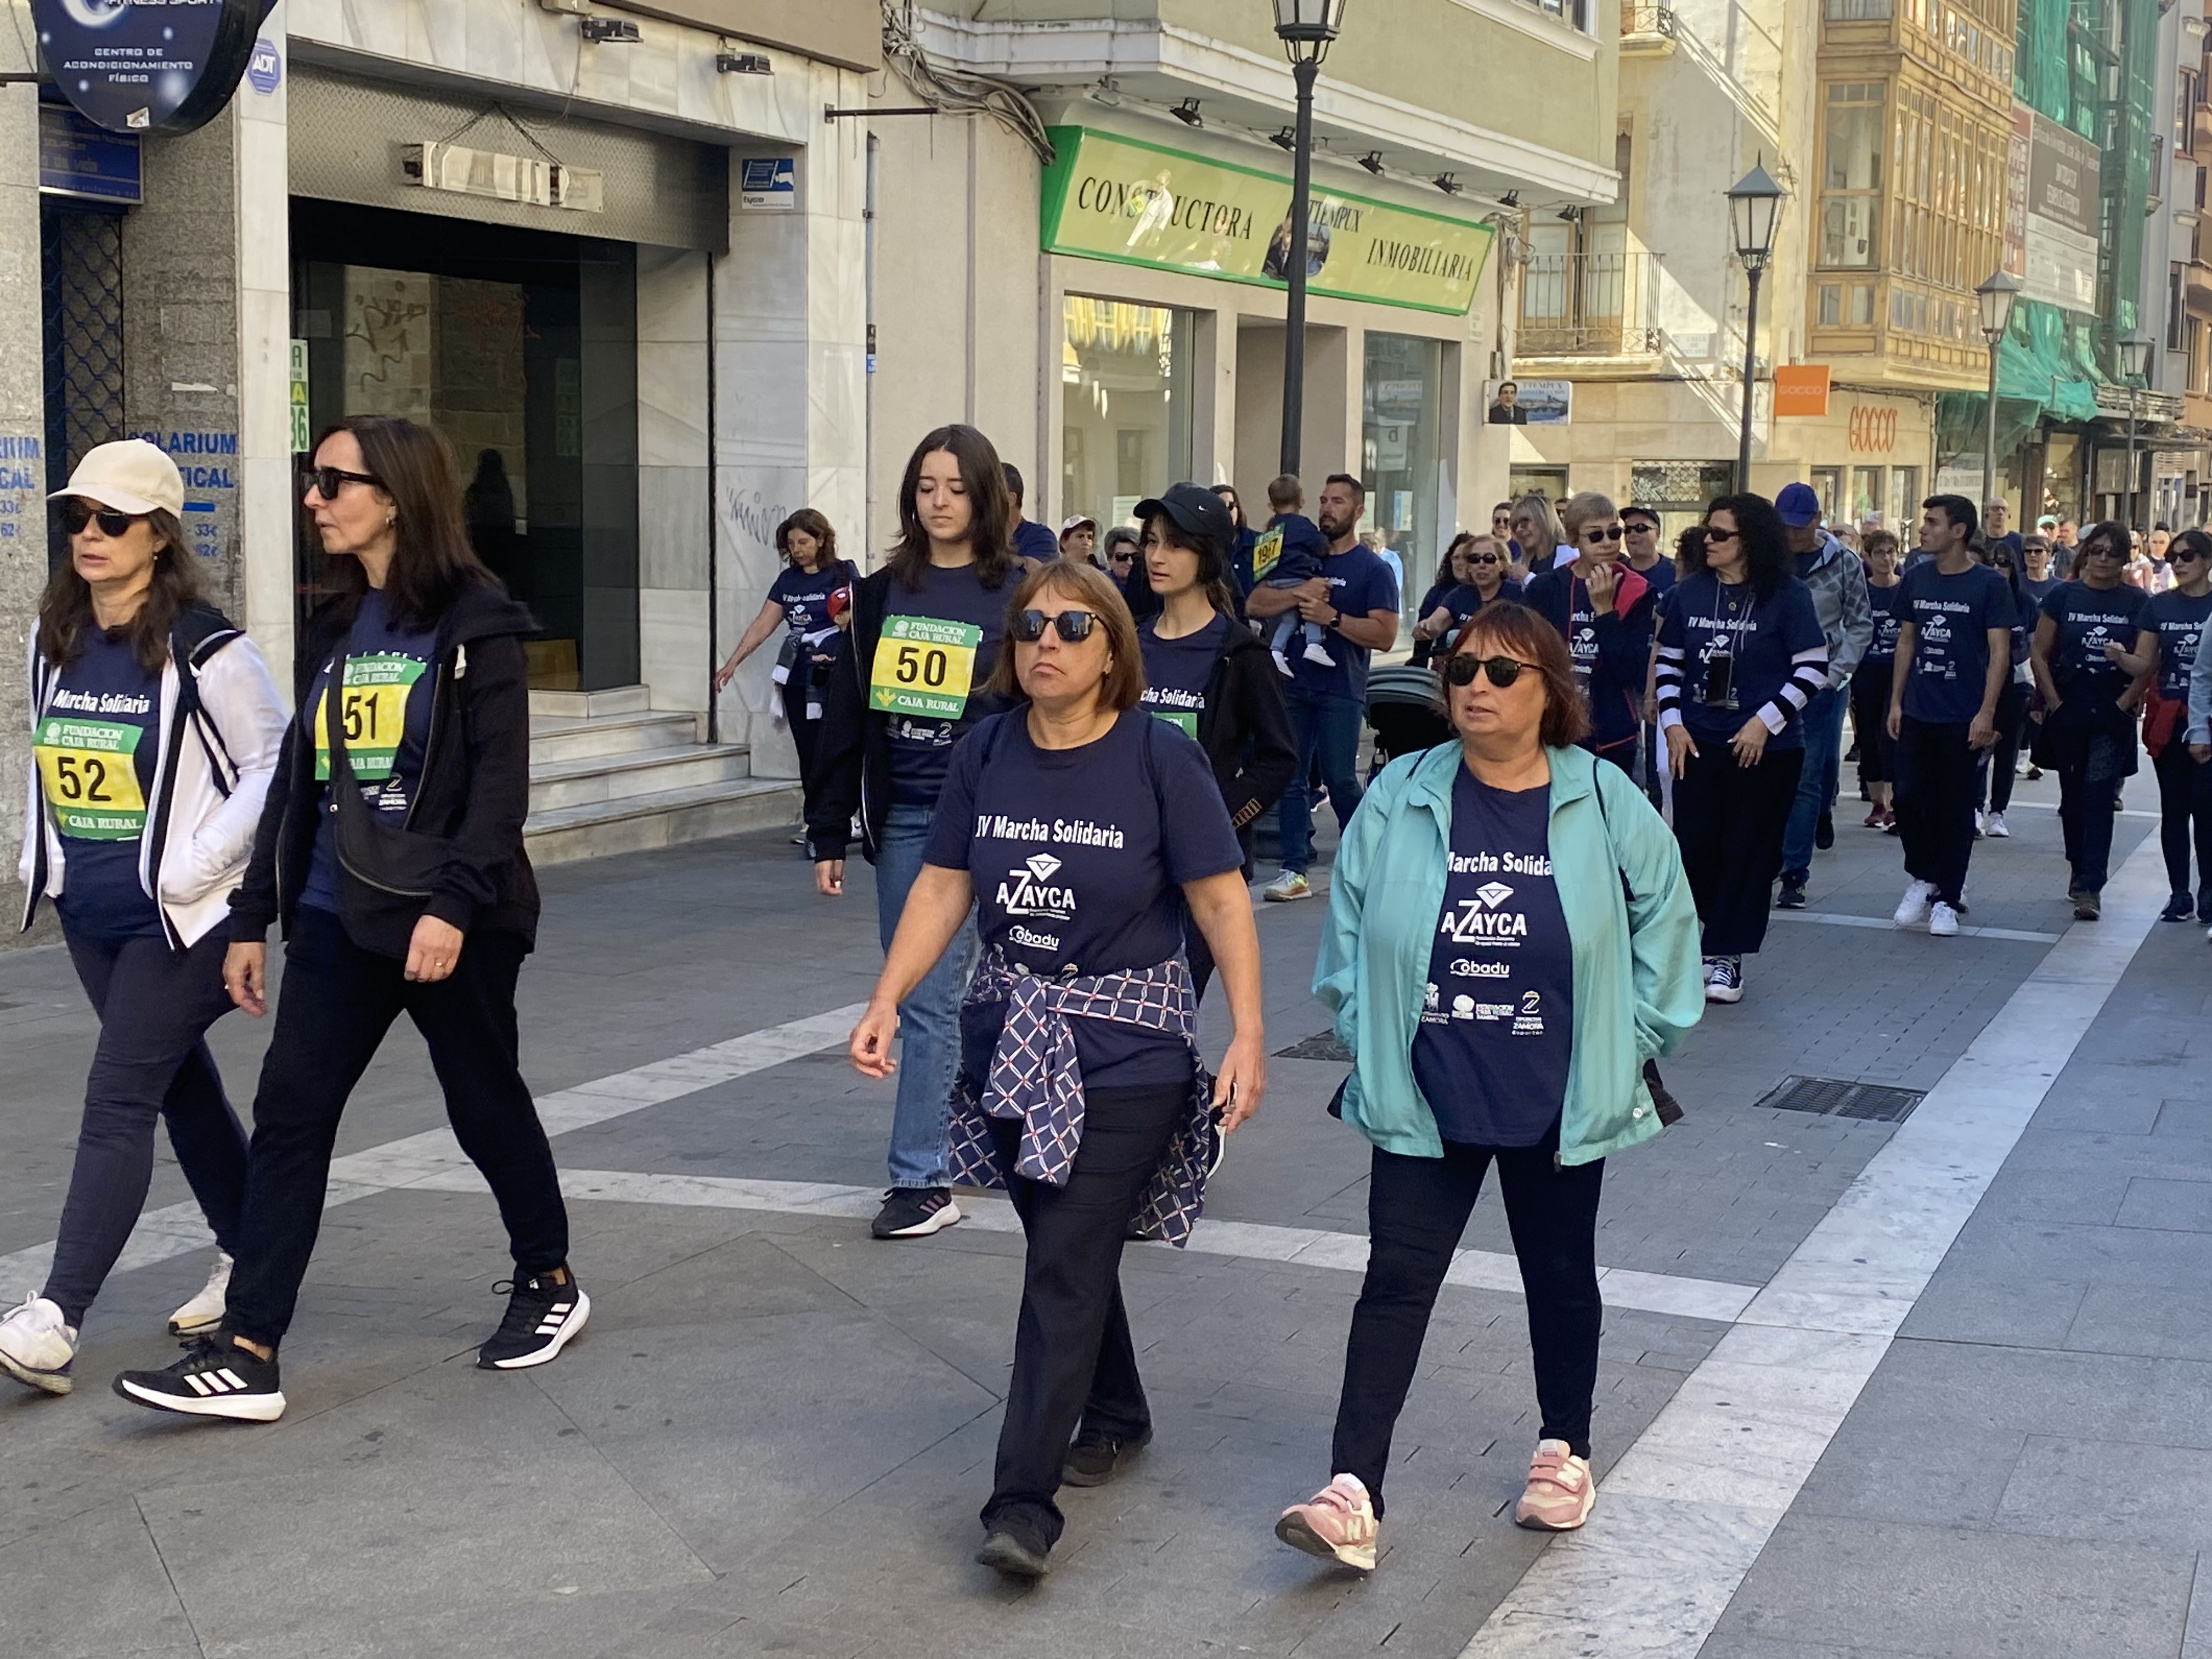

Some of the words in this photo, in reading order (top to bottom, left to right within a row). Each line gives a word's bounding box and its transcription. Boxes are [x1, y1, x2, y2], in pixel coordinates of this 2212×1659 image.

[94, 48, 143, 56] CENTRO
[147, 48, 163, 56] DE
[63, 61, 193, 69] ACONDICIONAMIENTO
[252, 53, 275, 74] ADT
[1367, 237, 1474, 281] INMOBILIARIA
[1779, 385, 1822, 395] GOCCO
[1849, 406, 1896, 452] GOCCO
[910, 622, 967, 637] FUNDACION
[1688, 616, 1699, 627] IV
[909, 630, 932, 641] CAJA
[933, 633, 963, 645] RURAL
[896, 646, 947, 686] 50
[53, 689, 99, 712] Marcha
[897, 695, 924, 708] CAJA
[926, 698, 960, 712] RURAL
[1160, 687, 1205, 709] Solidaria
[342, 692, 378, 740] 51
[63, 724, 125, 740] FUNDACION
[61, 736, 84, 747] CAJA
[87, 738, 120, 750] RURAL
[58, 756, 112, 802] 52
[69, 815, 95, 828] CAJA
[98, 817, 143, 830] RURAL
[975, 815, 992, 838] IV
[992, 815, 1048, 842] Marcha
[1052, 818, 1124, 849] Solidaria
[1503, 851, 1554, 876] Solida
[995, 869, 1076, 915] AZAYCA
[1441, 900, 1527, 943] AZAYCA
[1450, 958, 1510, 976] Cobadu
